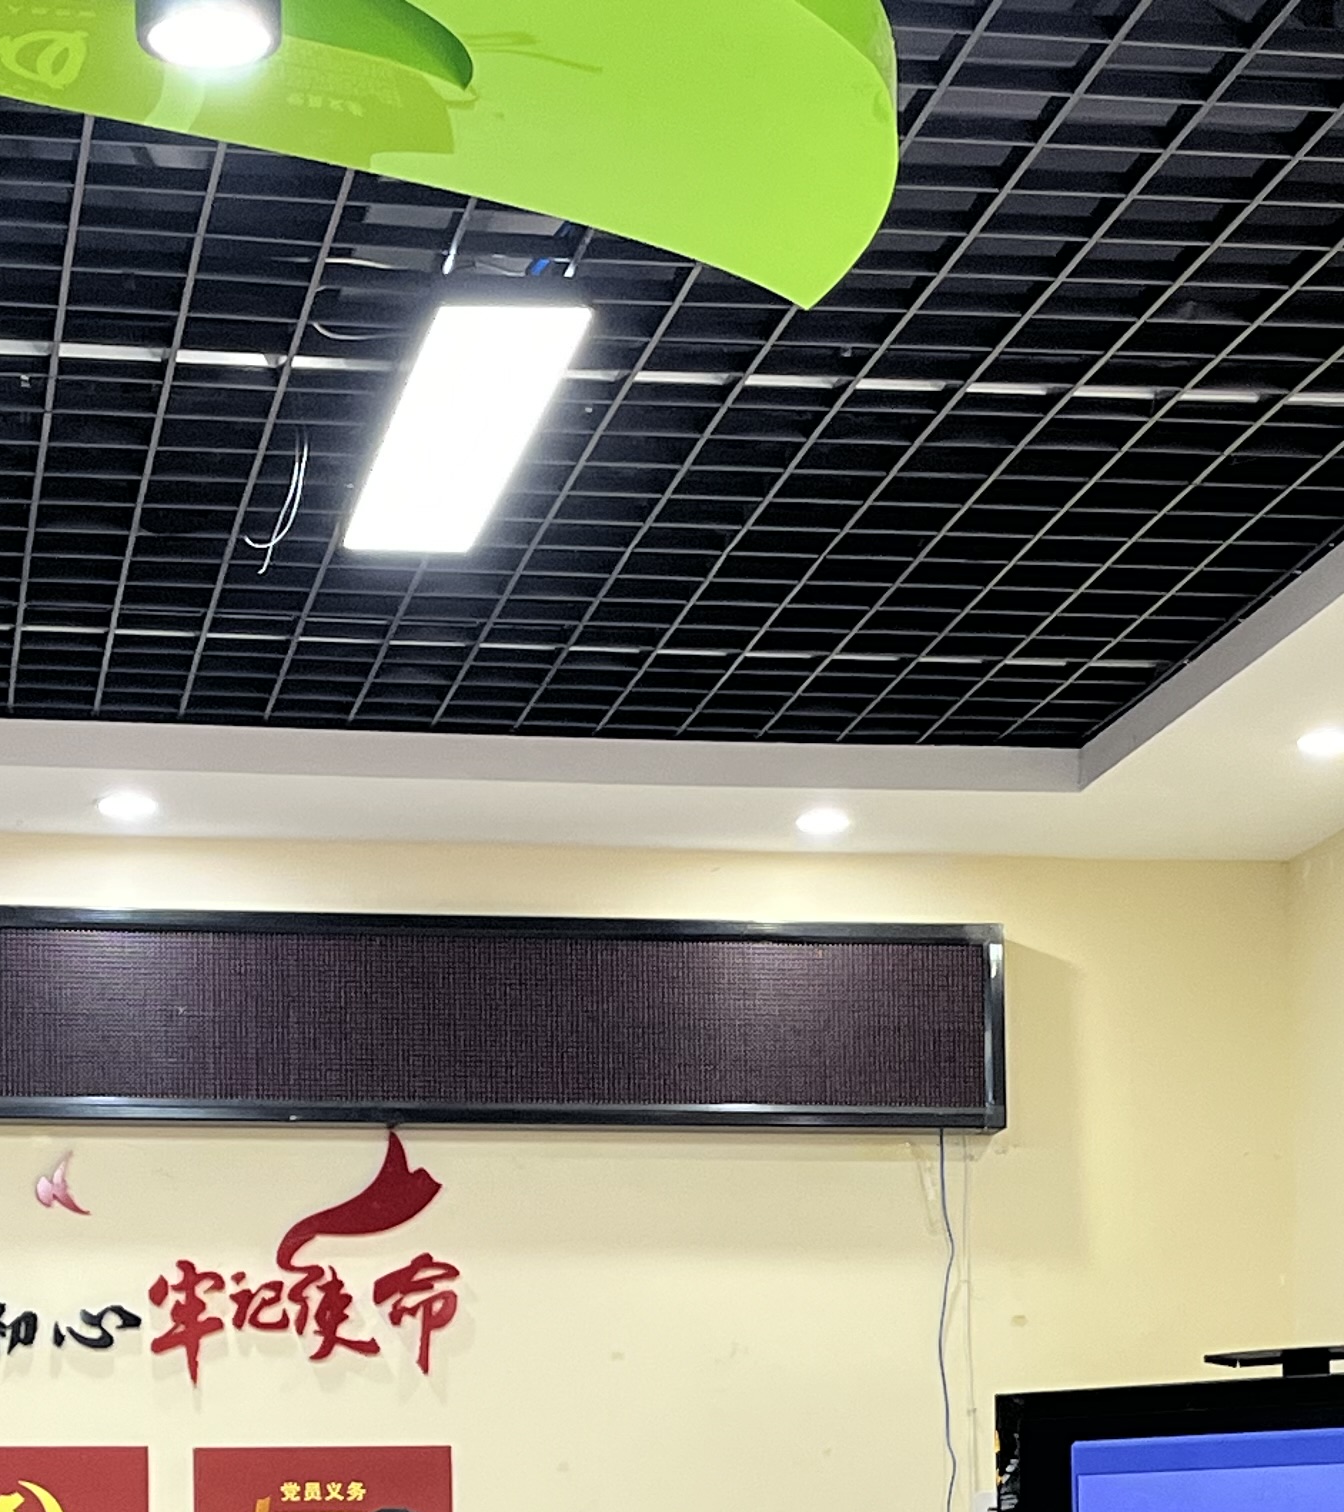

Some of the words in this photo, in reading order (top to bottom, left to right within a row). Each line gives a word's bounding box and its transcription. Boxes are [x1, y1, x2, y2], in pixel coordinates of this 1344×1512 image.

[148, 1252, 461, 1386] 牢记使命
[280, 1481, 367, 1502] 党员义务
